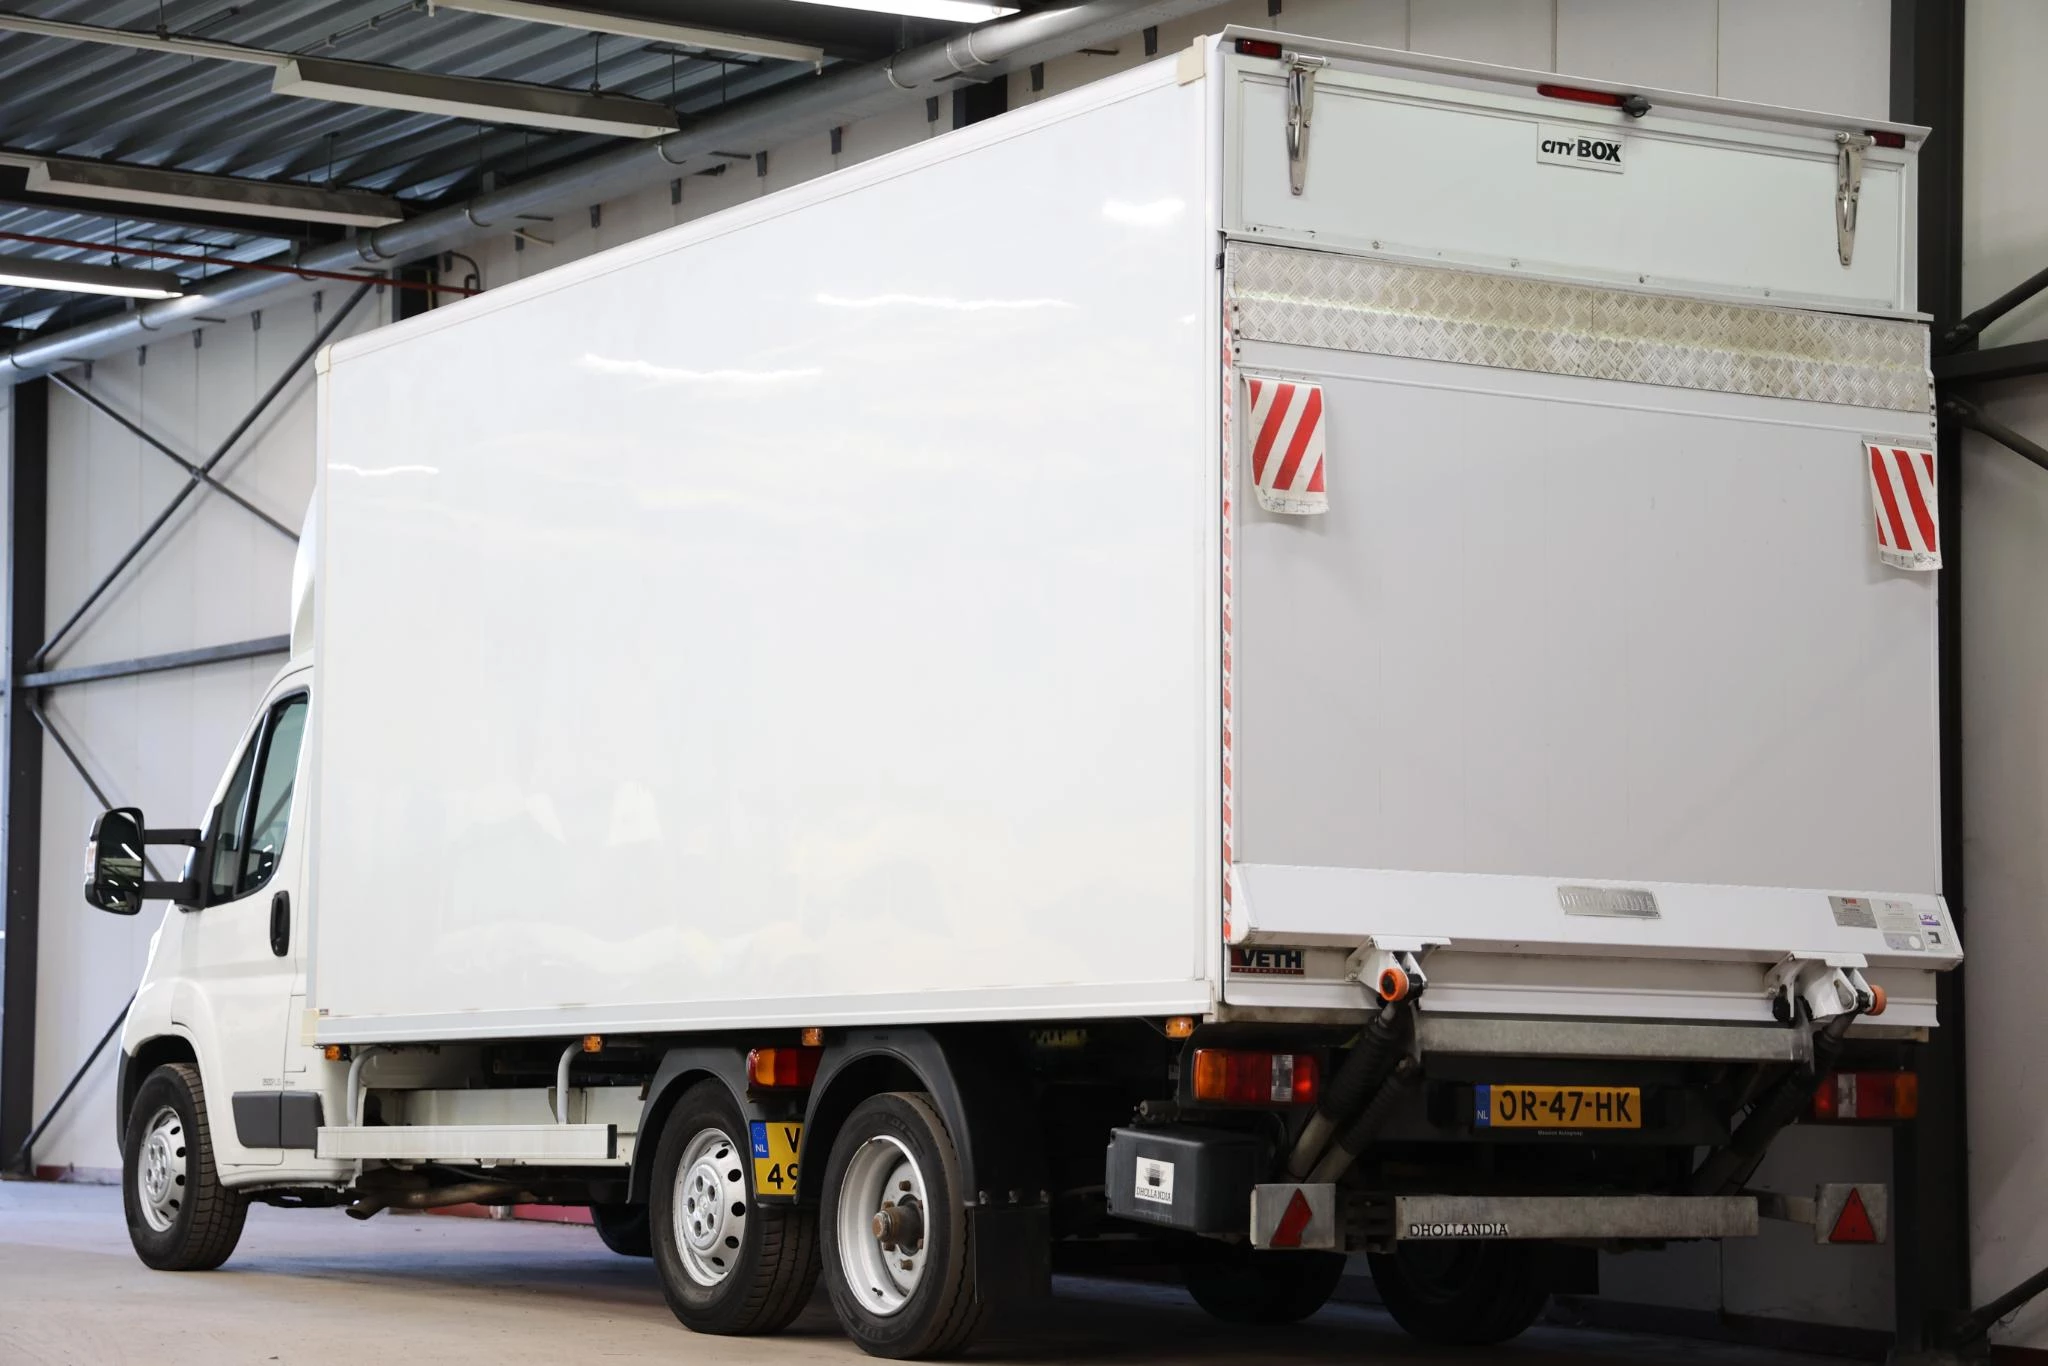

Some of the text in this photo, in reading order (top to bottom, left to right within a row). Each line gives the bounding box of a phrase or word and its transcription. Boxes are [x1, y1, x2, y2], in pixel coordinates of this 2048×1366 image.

[1541, 139, 1622, 163] CITY BOX
[1240, 948, 1302, 969] VETH
[1500, 1090, 1632, 1122] OR-47-HK
[1477, 1110, 1489, 1120] NL
[755, 1144, 767, 1153] NL
[1136, 1186, 1172, 1202] DHOLLANDIA
[1410, 1223, 1509, 1237] DHOLLANDIA
